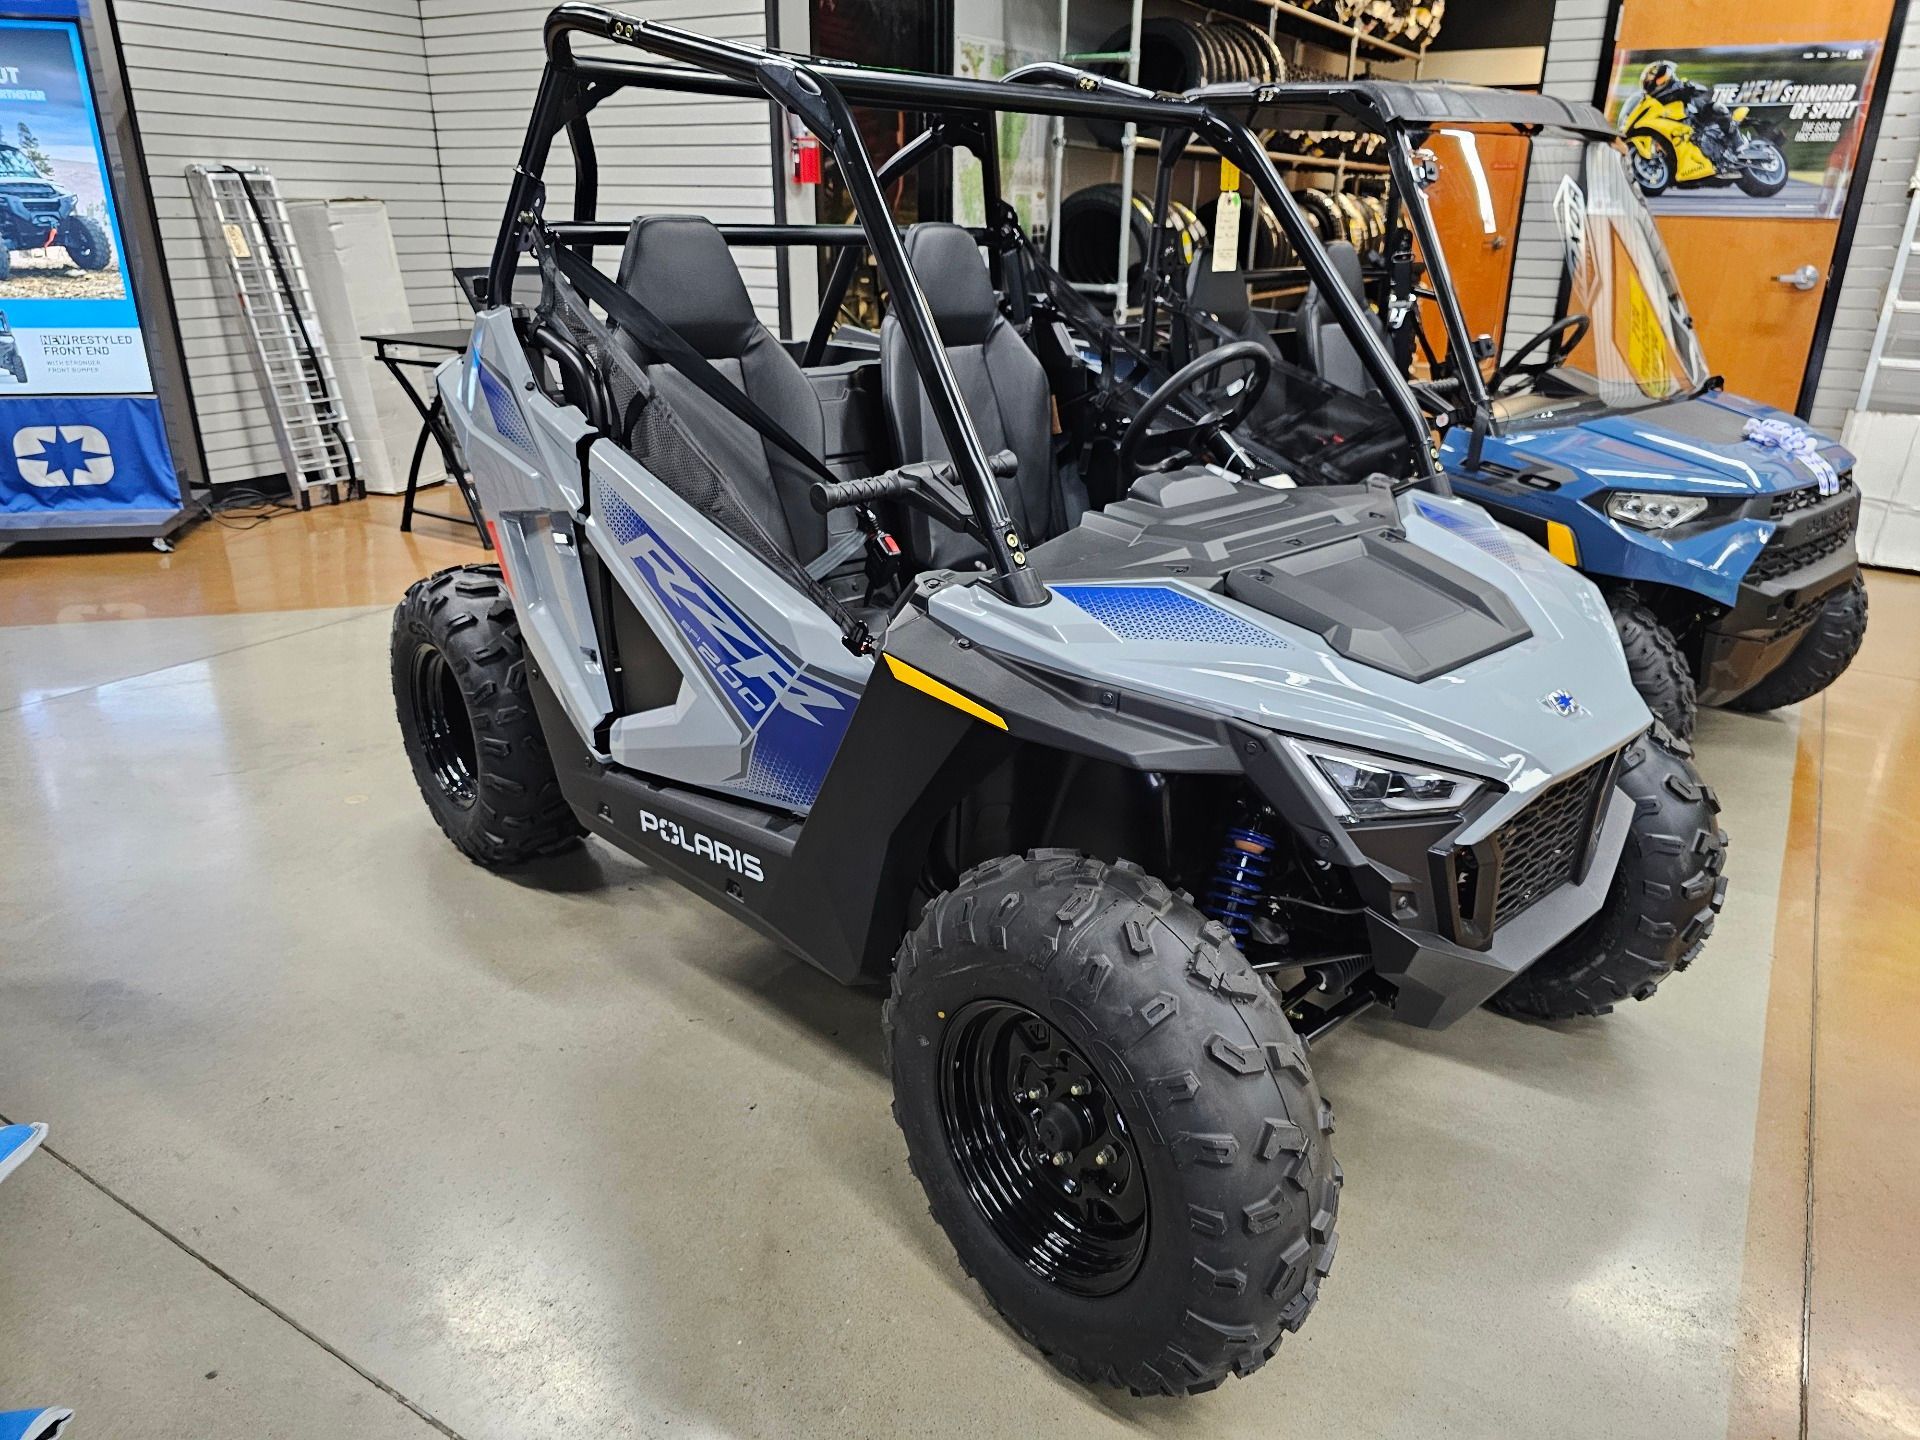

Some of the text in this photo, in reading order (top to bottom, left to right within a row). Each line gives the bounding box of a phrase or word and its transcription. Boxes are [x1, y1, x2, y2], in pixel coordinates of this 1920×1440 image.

[1712, 80, 1857, 103] THE NEW STANDARD
[1789, 101, 1859, 120] OF SPORT
[40, 335, 133, 345] NEW RESTYLED
[43, 346, 110, 356] FRONT END
[622, 533, 845, 727] RZR
[697, 640, 766, 713] 200
[639, 809, 765, 882] POLARIS
